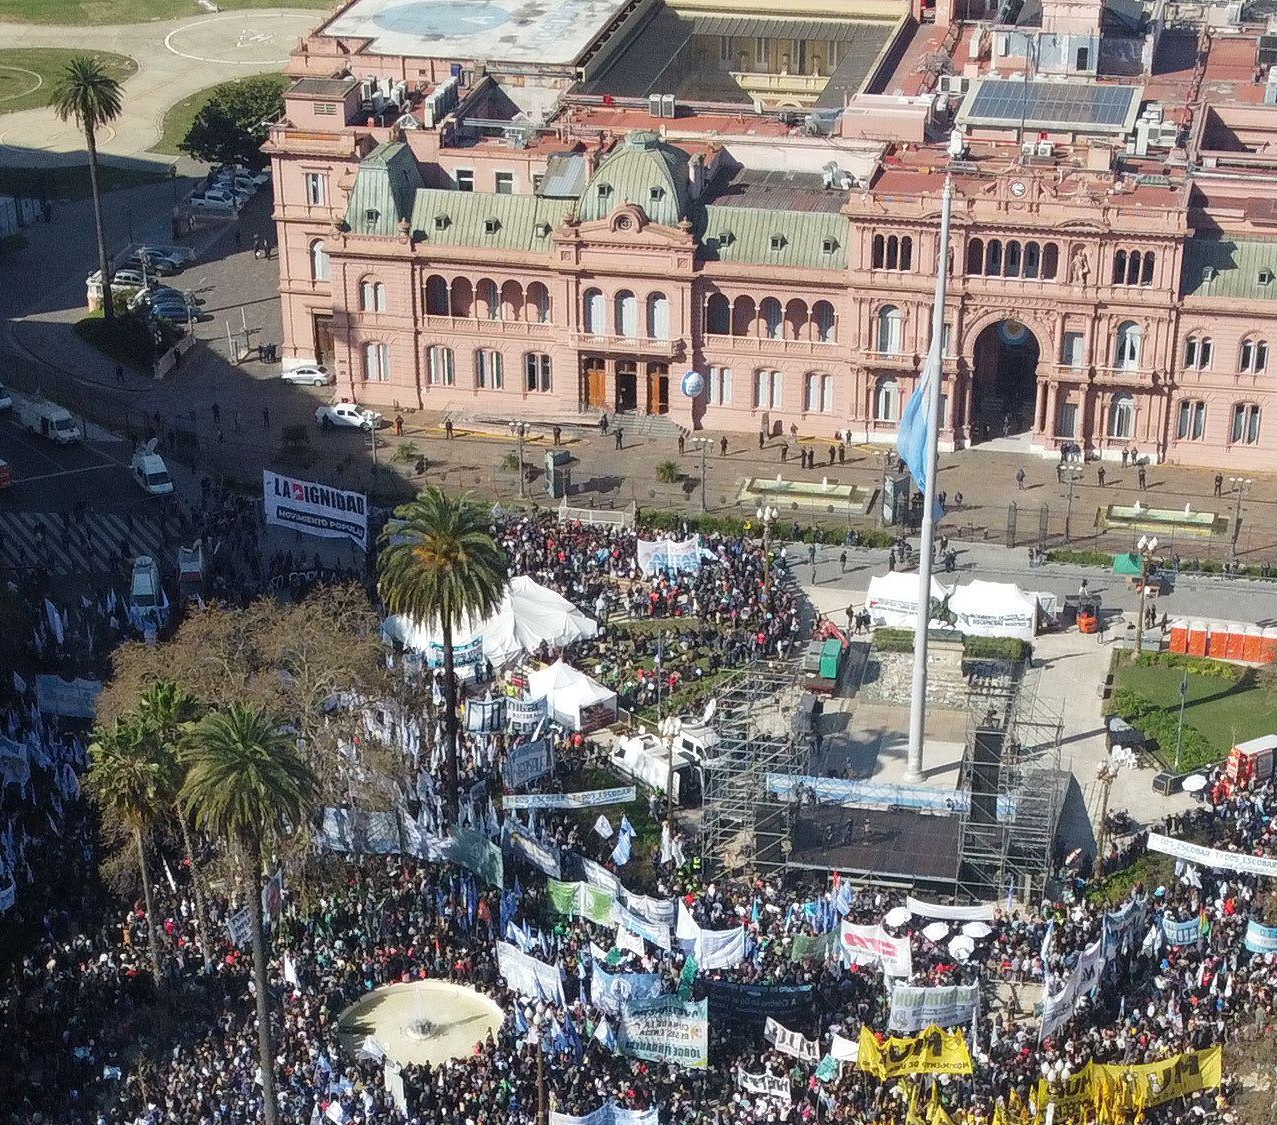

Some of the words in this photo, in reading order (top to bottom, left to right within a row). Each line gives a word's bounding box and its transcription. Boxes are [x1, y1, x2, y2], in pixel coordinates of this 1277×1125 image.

[275, 477, 291, 498] LA
[292, 480, 365, 515] DIGNIDAD
[1177, 841, 1211, 857] ESCOBAR
[1242, 857, 1277, 868] ESCOBAR
